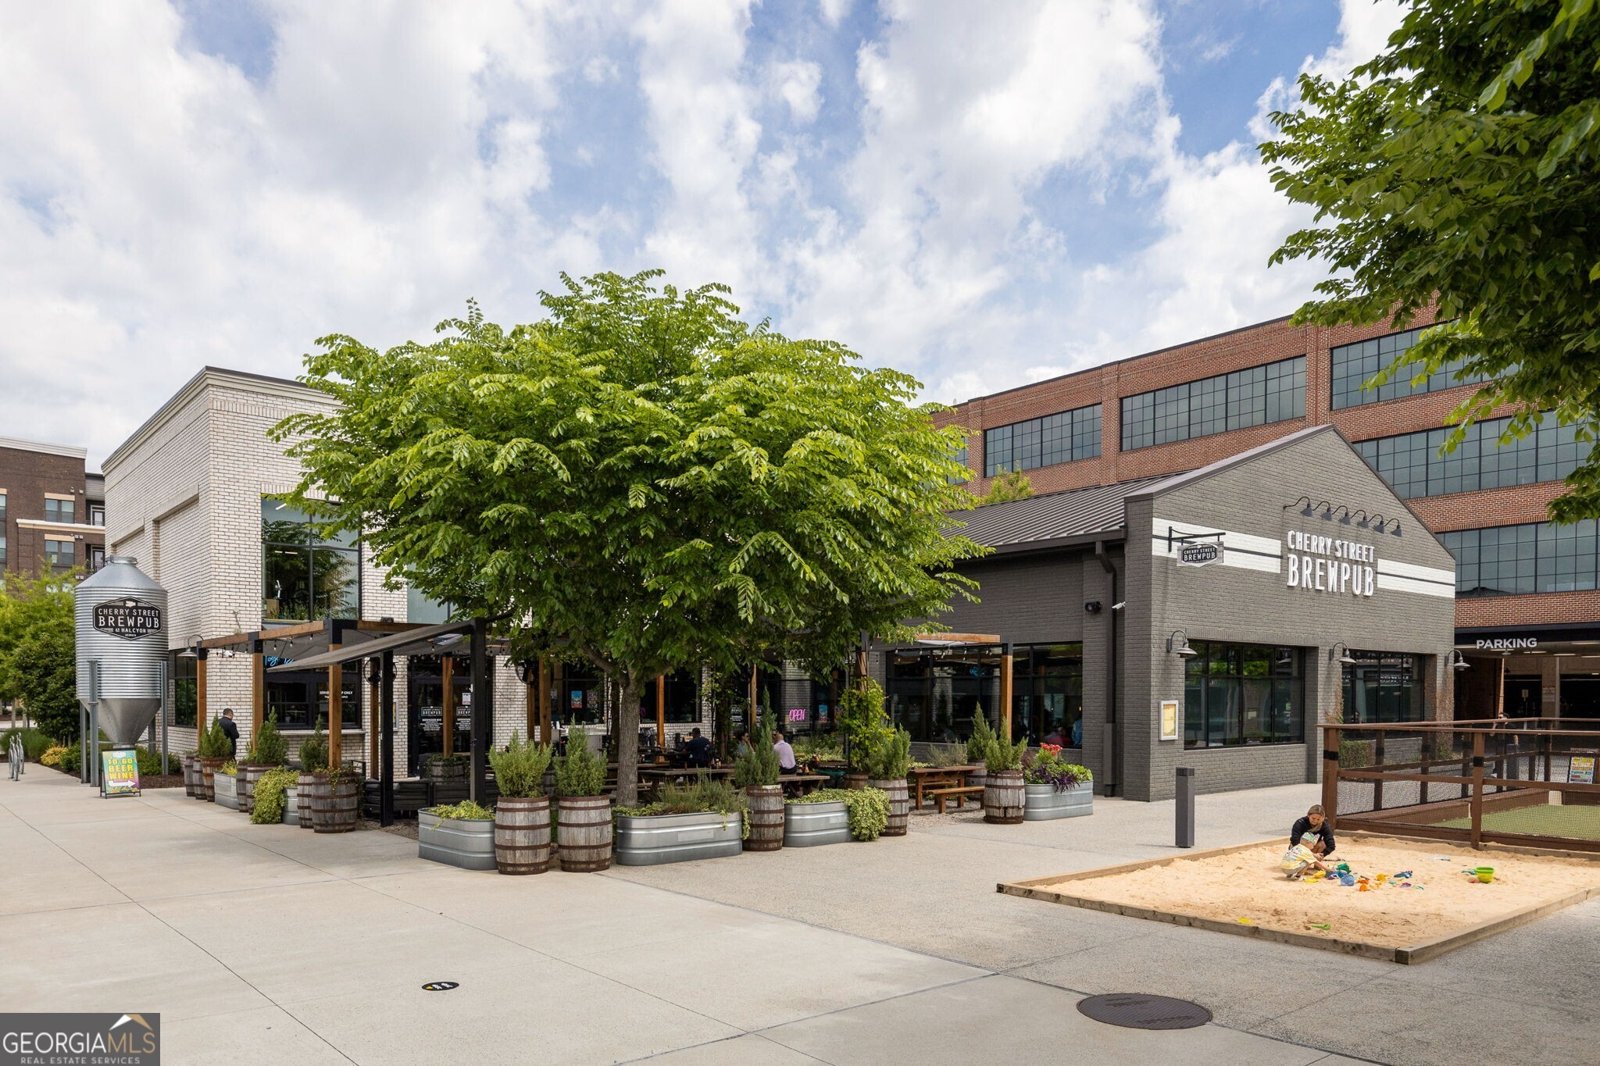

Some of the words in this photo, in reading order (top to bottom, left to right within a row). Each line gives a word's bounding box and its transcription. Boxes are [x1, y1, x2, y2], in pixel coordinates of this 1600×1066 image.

[1287, 530, 1332, 555] CHERRY
[1334, 540, 1375, 562] STREET
[1183, 551, 1216, 561] BREWPUB
[1286, 554, 1374, 596] BREWPUB
[98, 608, 130, 616] CHERRY
[132, 609, 159, 617] STREET
[98, 615, 160, 629] BREWPUB
[1476, 637, 1538, 650] PARKING
[789, 708, 806, 722] OPEN
